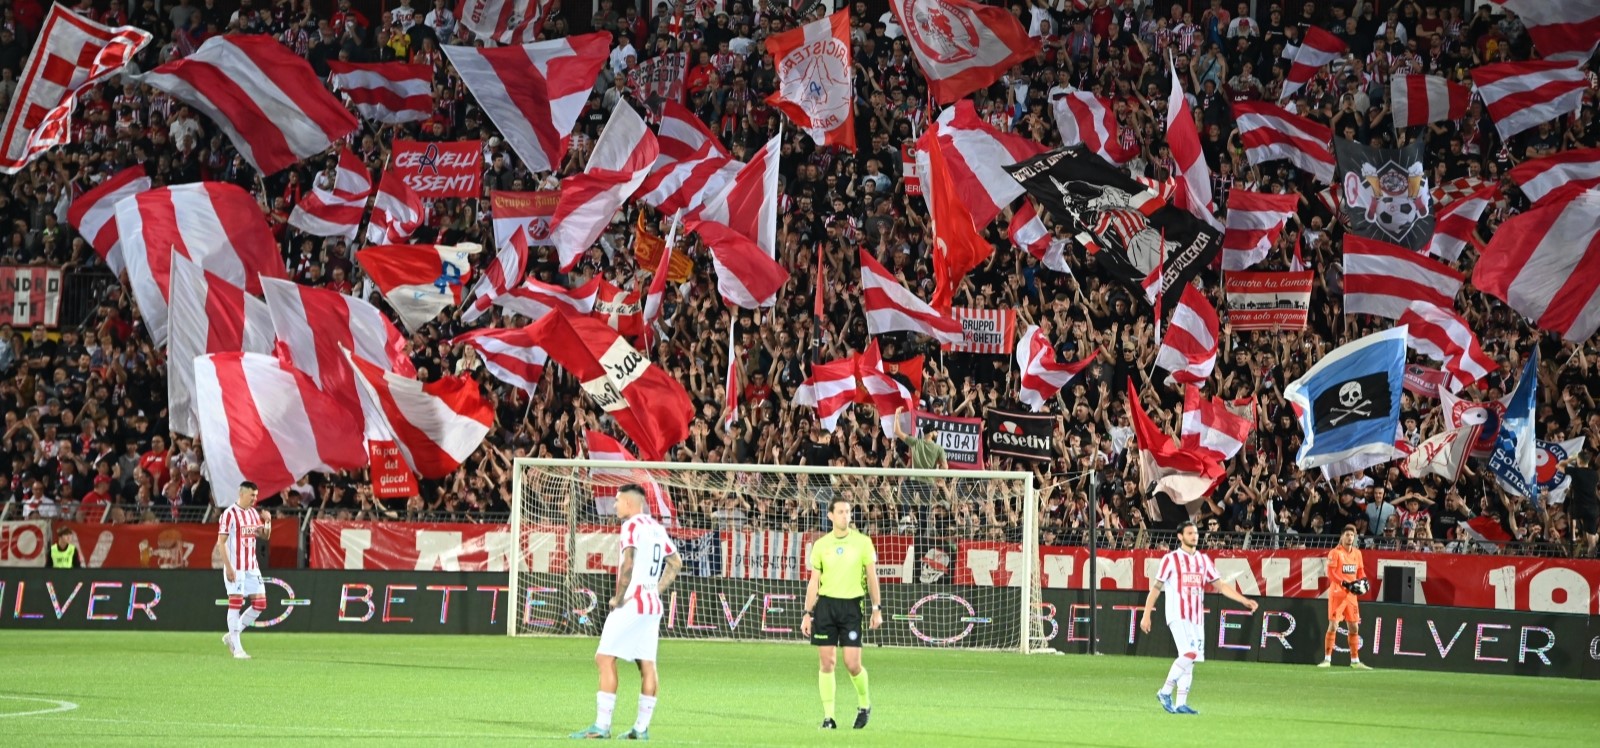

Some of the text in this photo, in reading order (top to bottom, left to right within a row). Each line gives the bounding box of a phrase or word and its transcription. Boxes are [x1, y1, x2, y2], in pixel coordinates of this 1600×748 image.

[0, 277, 59, 292] NDRO
[1264, 278, 1279, 288] ha
[1253, 312, 1271, 320] solo
[962, 319, 995, 332] GRUPPO
[918, 418, 977, 434] PRENTAL
[380, 472, 408, 487] gioco!
[649, 543, 661, 577] 9
[338, 583, 598, 627] BETTER
